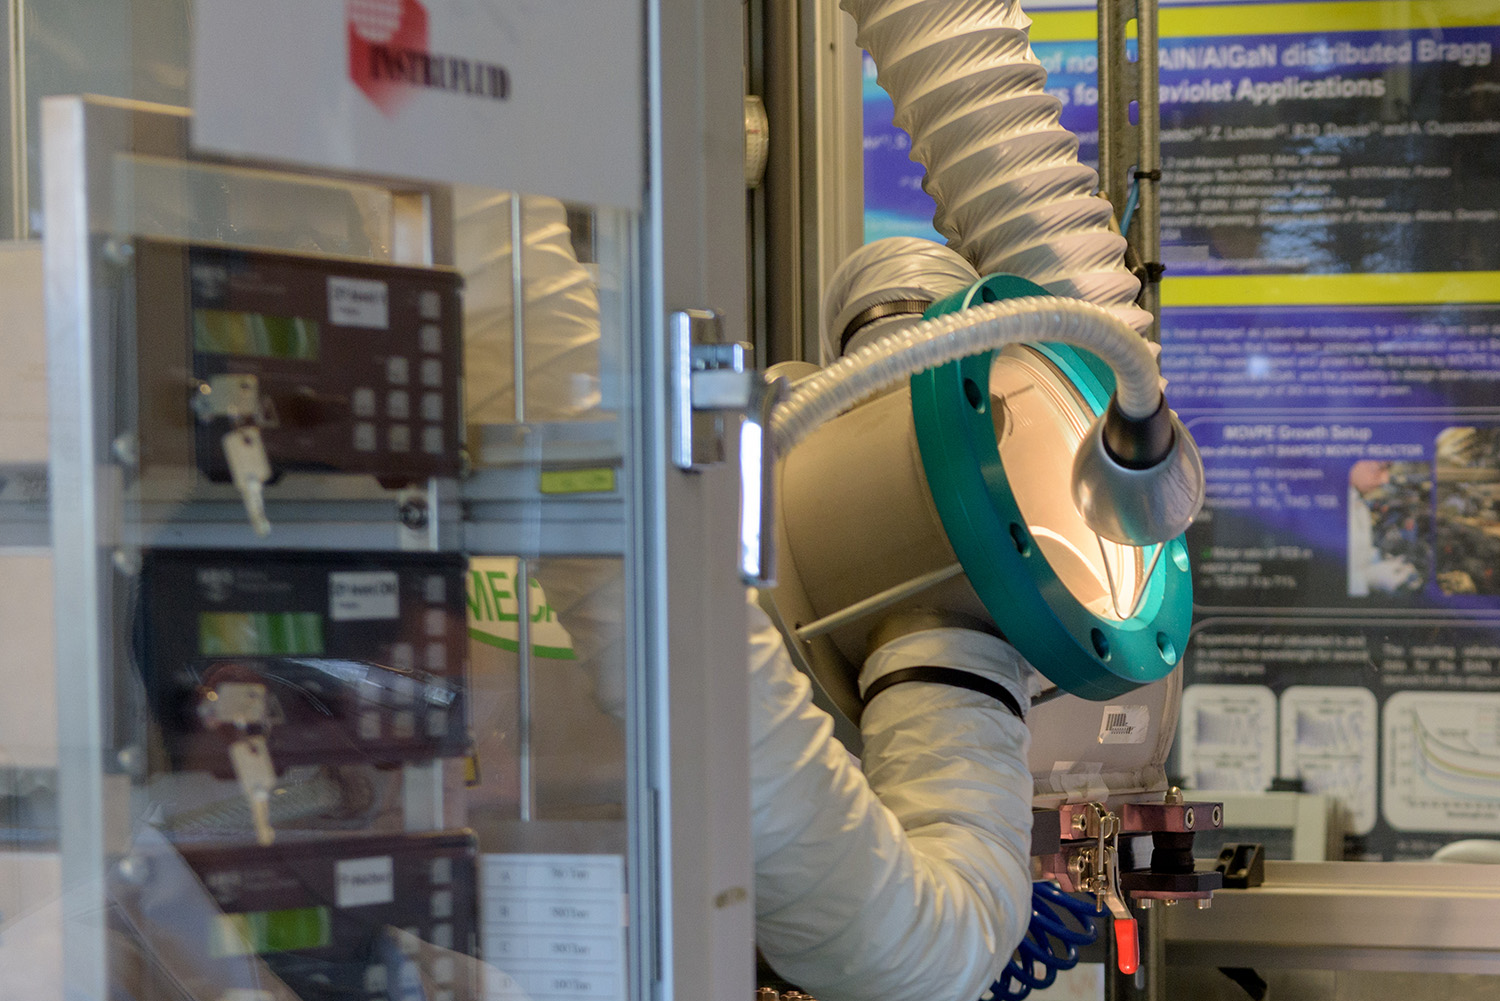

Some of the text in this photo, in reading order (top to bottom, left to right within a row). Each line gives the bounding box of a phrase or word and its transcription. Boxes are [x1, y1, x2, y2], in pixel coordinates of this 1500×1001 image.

[1282, 37, 1412, 68] distributed
[1417, 39, 1492, 66] Bragg
[1237, 74, 1386, 105] Applications
[1331, 424, 1373, 442] Setup
